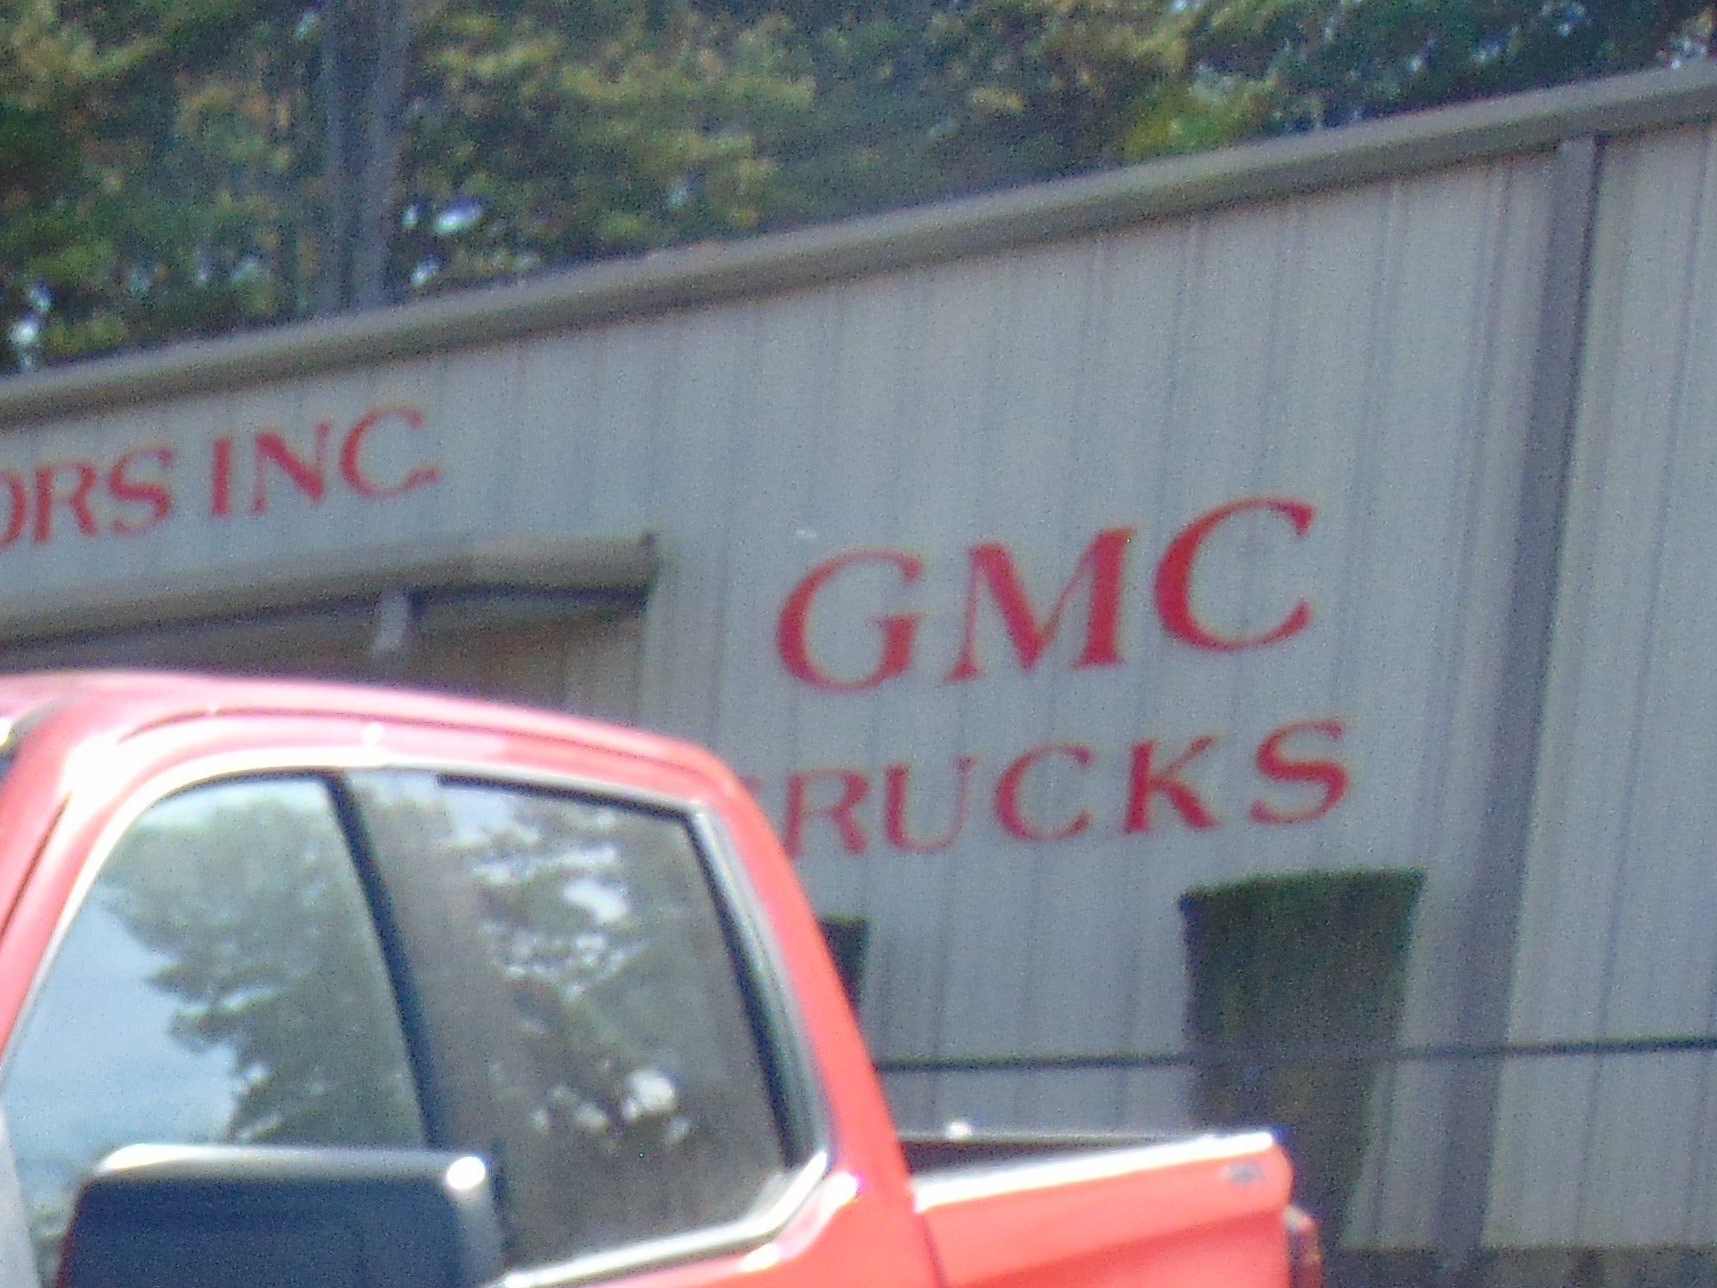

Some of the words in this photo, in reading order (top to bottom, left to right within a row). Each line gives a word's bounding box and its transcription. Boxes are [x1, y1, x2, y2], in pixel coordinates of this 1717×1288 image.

[210, 402, 442, 518] INC
[774, 496, 1318, 694] GMC
[739, 718, 1352, 861] RUCKS
